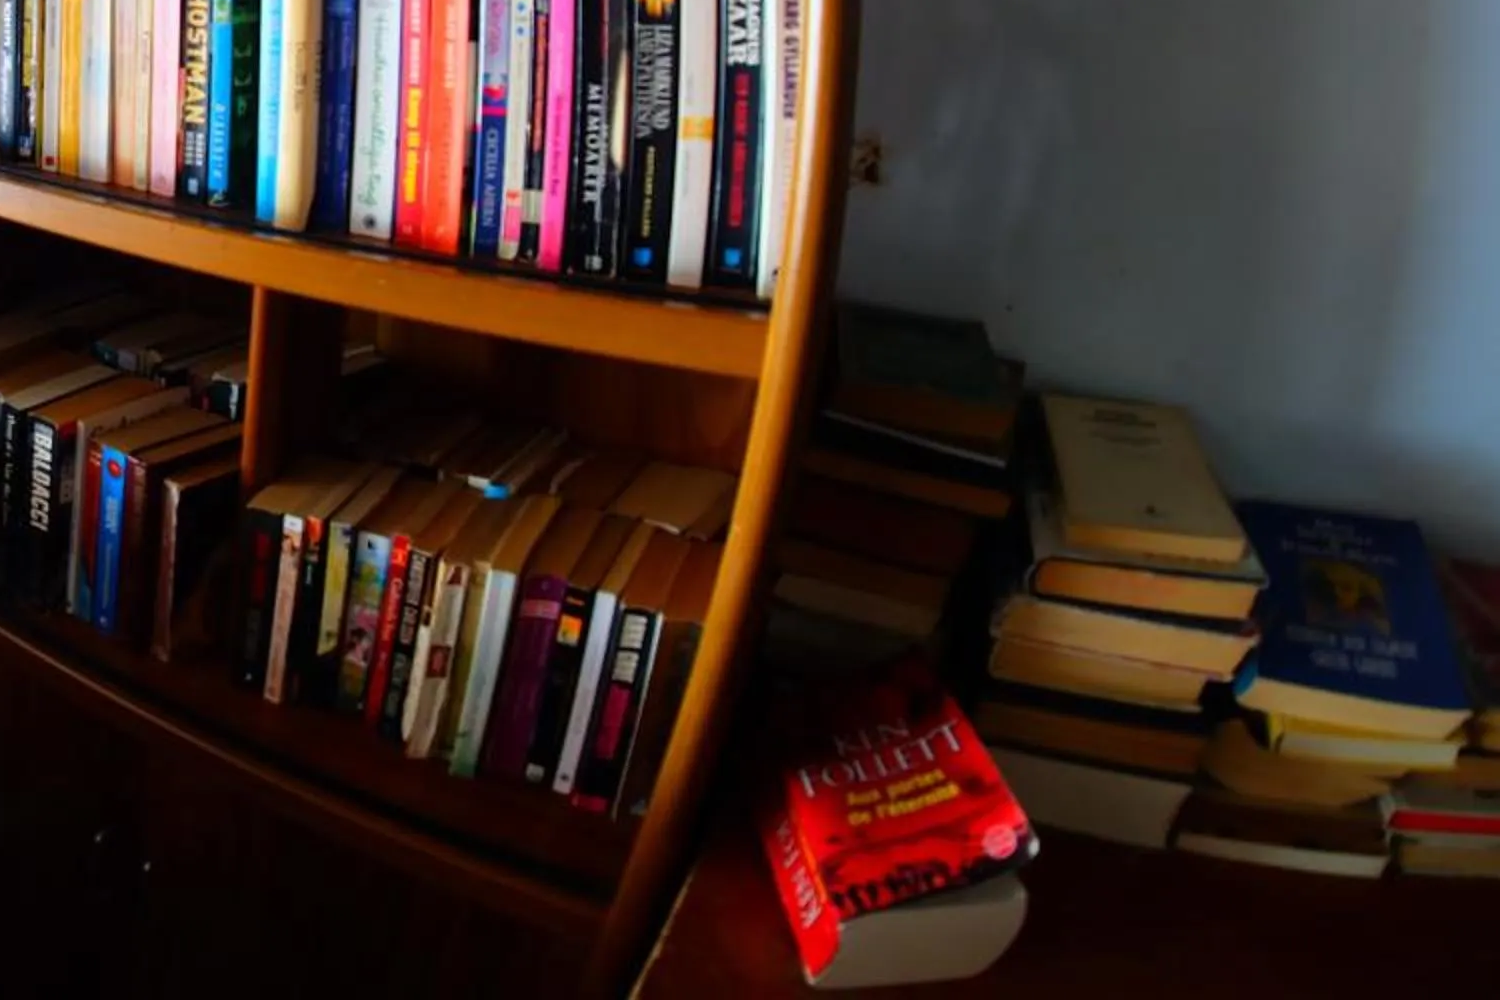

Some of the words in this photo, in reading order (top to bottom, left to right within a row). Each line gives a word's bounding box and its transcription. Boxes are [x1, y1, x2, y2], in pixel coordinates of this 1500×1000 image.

[483, 127, 498, 180] CECELIA
[584, 83, 603, 203] MEMOARER
[481, 183, 496, 228] AHERN
[28, 433, 53, 534] BALDACCI
[799, 719, 962, 798] FOLLETT
